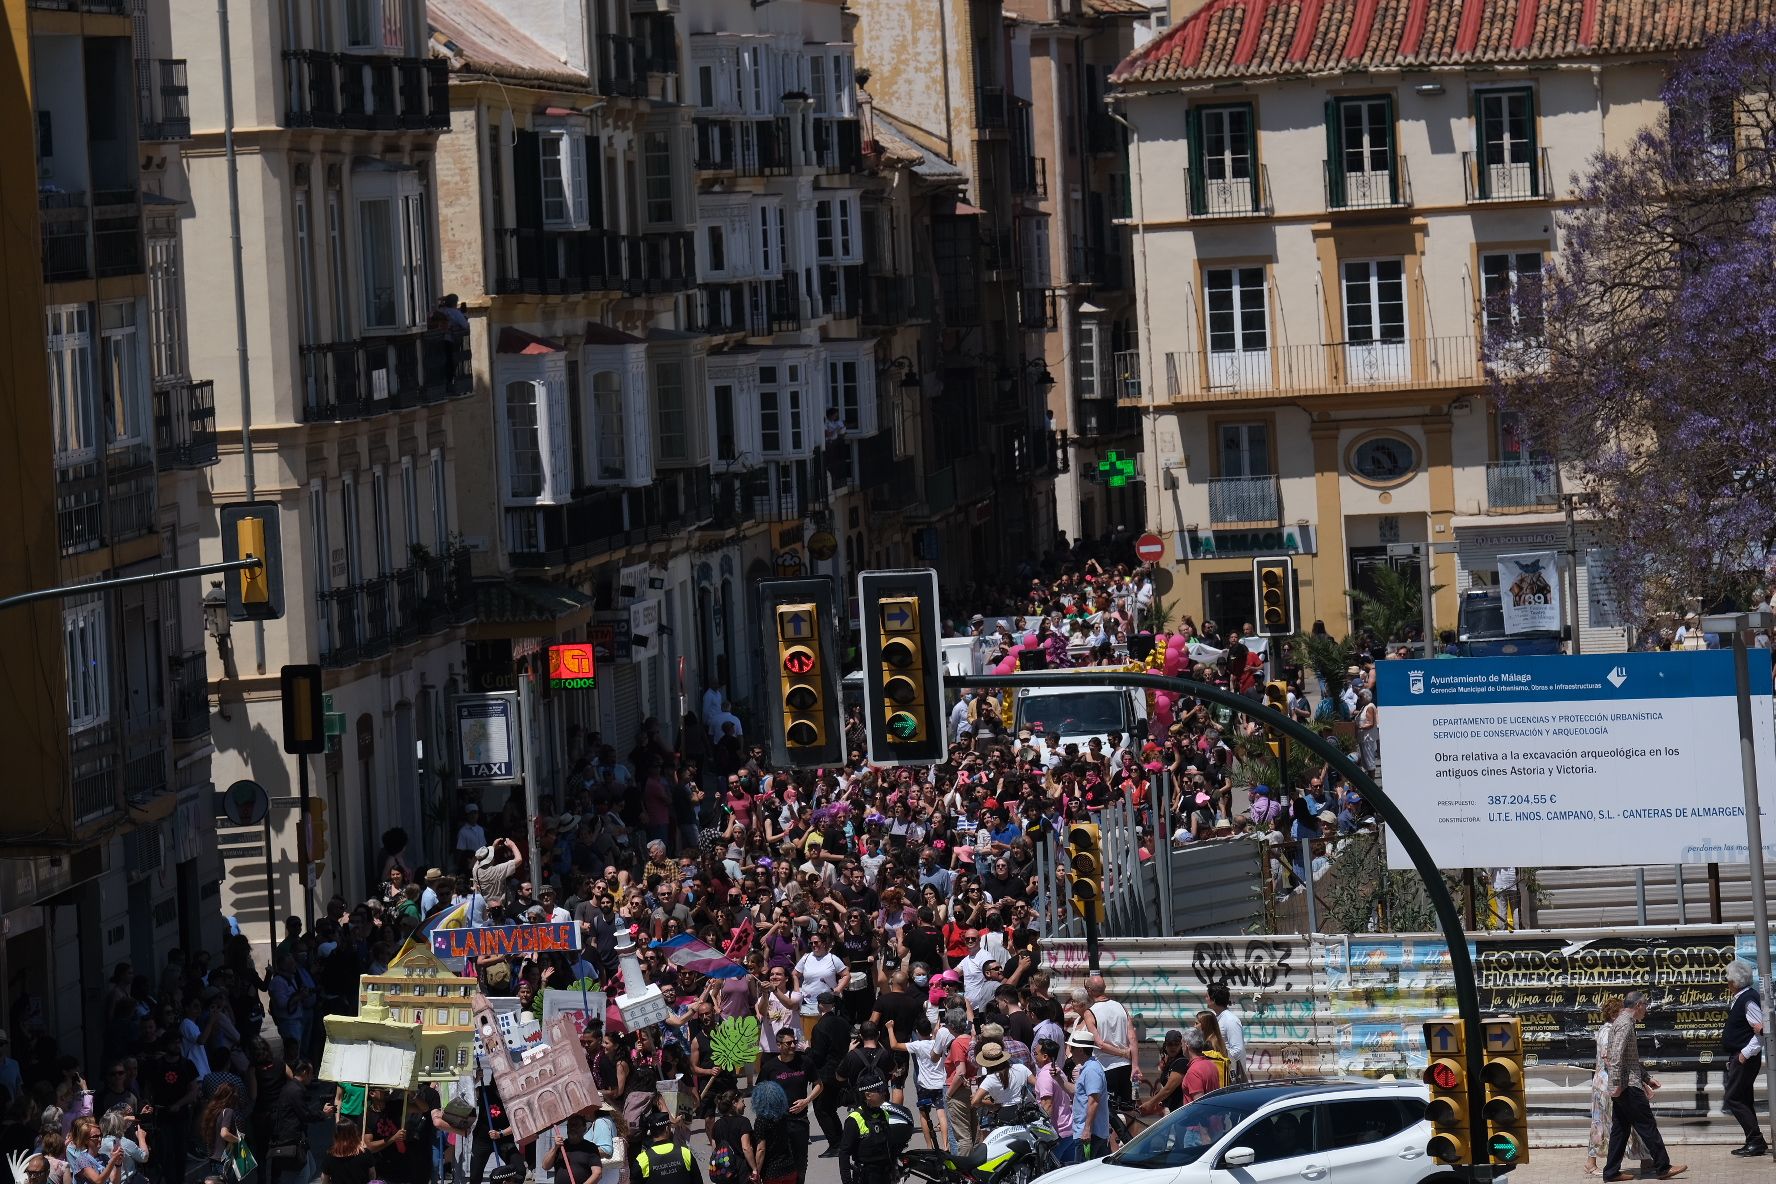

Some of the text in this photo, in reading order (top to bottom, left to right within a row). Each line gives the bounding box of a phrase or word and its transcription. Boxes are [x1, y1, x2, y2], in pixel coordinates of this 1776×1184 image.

[1190, 533, 1298, 554] FARMACIA
[1430, 675, 1487, 685] Ayuntamiento
[1489, 674, 1499, 682] de
[1501, 673, 1531, 682] Málaga
[1433, 717, 1495, 726] DEPARTAMENTO
[1497, 717, 1508, 725] DE
[1510, 715, 1550, 724] LICENCIAS
[1558, 713, 1609, 723] PROTECCIÓN
[1610, 712, 1664, 721] URBANÍSTICA
[1433, 726, 1609, 739] SERVICIO DE CONSERVACIÓN Y ARQUEOLOGÍA
[1435, 752, 1459, 762] Obra
[1461, 751, 1499, 761] relativa
[1510, 751, 1520, 760] la
[1522, 749, 1578, 760] excavación
[1580, 747, 1646, 760] arqueológica
[1649, 748, 1662, 756] en
[1665, 747, 1679, 756] los
[468, 763, 506, 776] TAXI
[1435, 764, 1597, 779] antiguos cines Astoria y Victoria.
[1549, 794, 1557, 803] €
[1488, 812, 1513, 822] U.T.E.
[1515, 811, 1544, 821] HNOS.
[1546, 810, 1596, 821] CAMPANO,
[1599, 809, 1615, 820] S.L.
[1622, 808, 1673, 819] CANTERAS
[1675, 808, 1688, 818] DE
[1687, 844, 1722, 853] perdonen
[480, 925, 570, 956] INVISIBLE
[1482, 950, 1563, 971] FONDO
[1566, 948, 1650, 971] FONDO
[1653, 945, 1736, 971] FONDO
[1568, 970, 1650, 987] FLAMENCO
[1508, 990, 1541, 1009] última
[1545, 990, 1565, 1007] cita
[1680, 986, 1715, 1006] última
